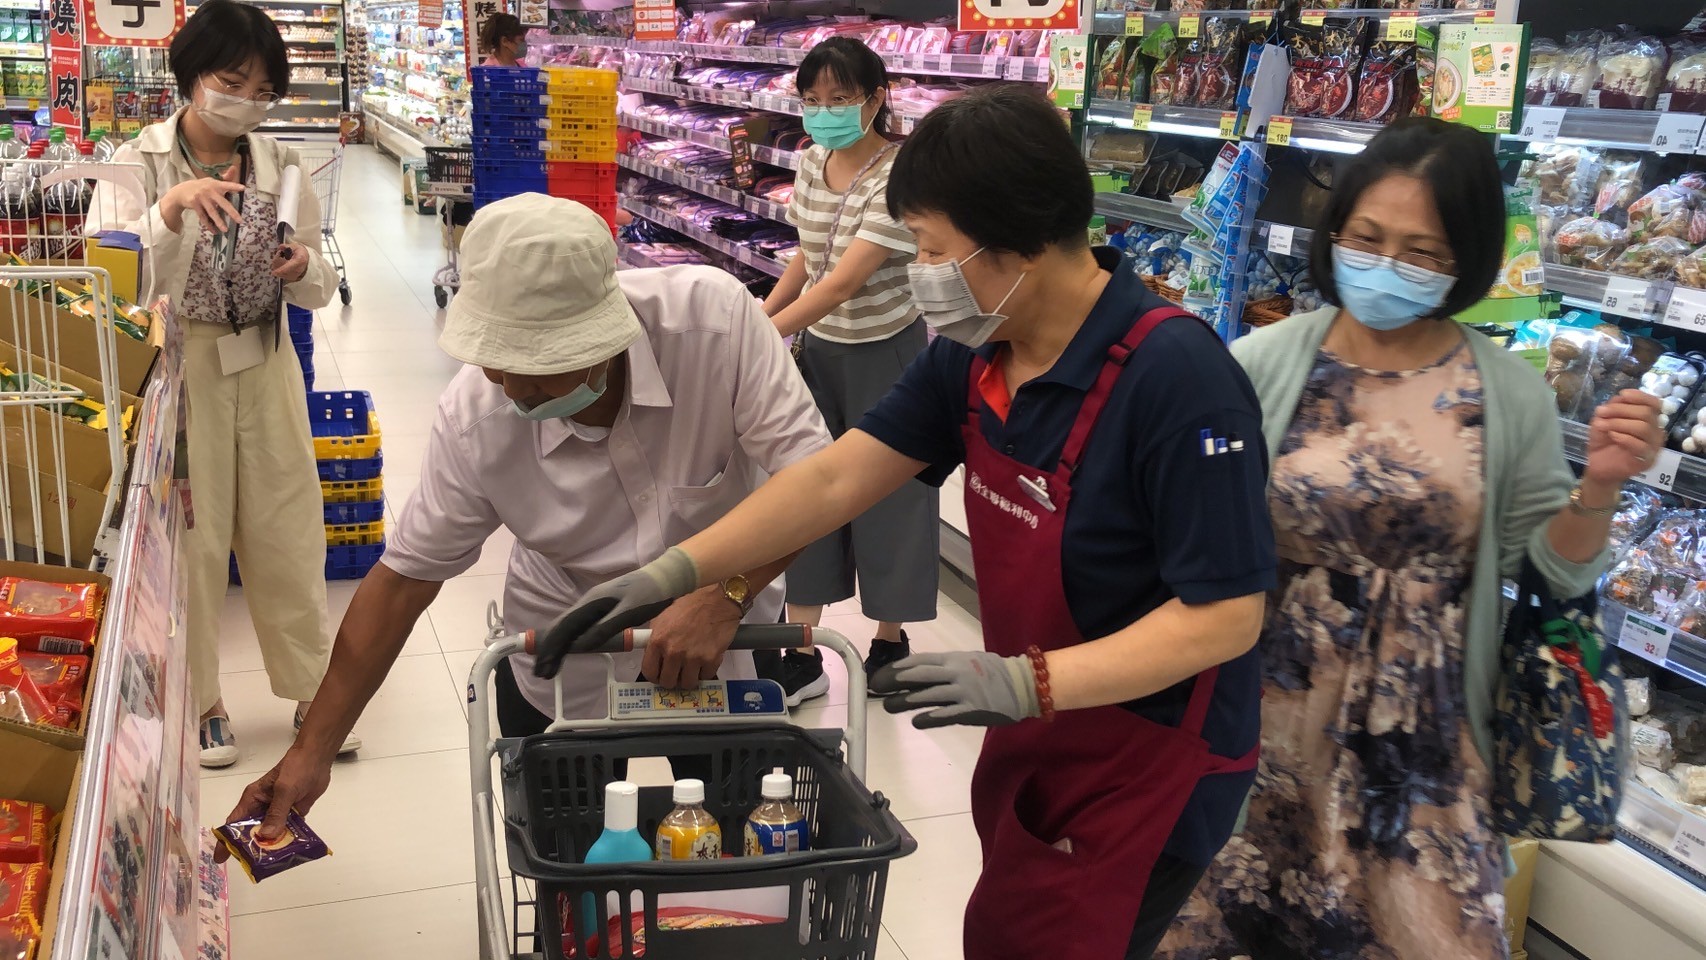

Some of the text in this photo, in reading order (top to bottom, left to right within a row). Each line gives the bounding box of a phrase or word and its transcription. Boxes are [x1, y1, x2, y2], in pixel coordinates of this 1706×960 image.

[1399, 29, 1413, 38] 149
[1276, 133, 1288, 143] 180
[1694, 313, 1706, 326] 65
[1659, 473, 1671, 486] 92
[1644, 642, 1655, 654] 32
